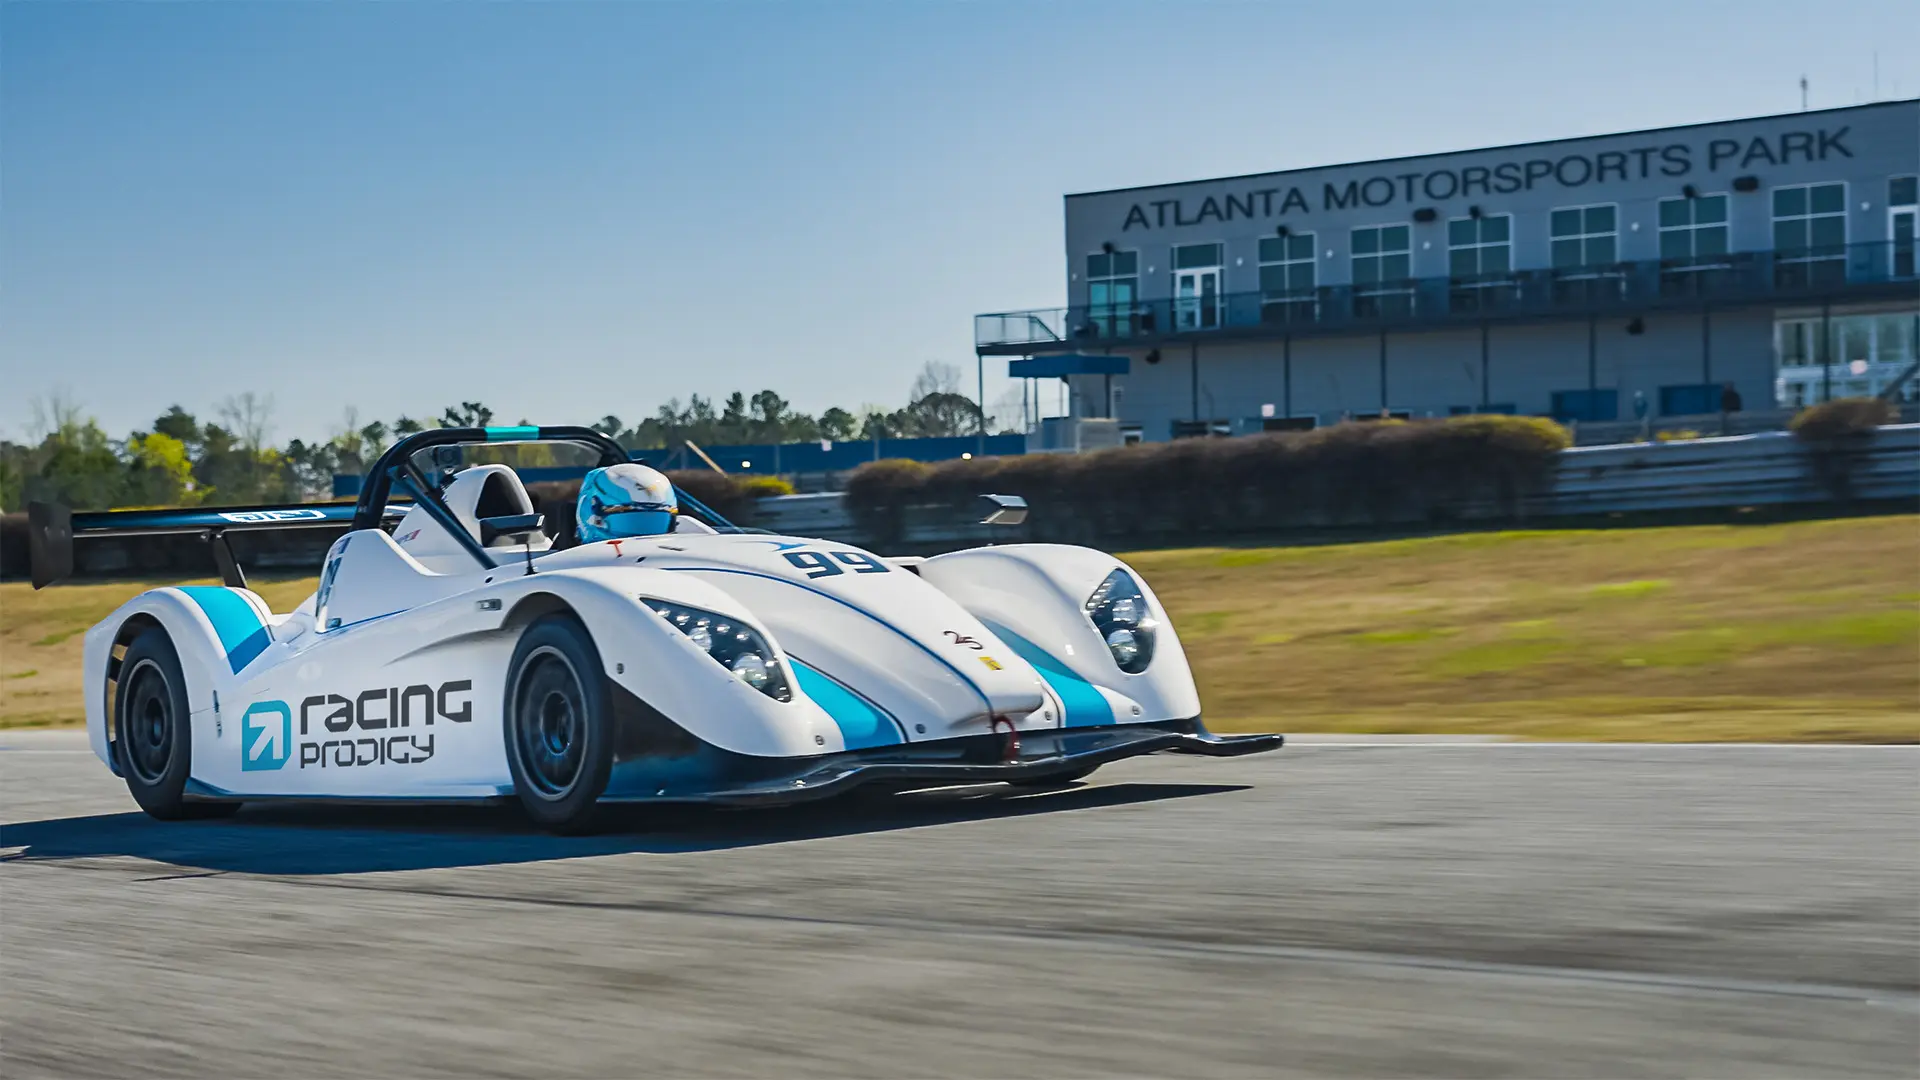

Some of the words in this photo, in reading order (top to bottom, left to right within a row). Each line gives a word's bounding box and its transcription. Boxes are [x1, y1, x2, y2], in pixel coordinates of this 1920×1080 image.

[1122, 186, 1310, 233] ATLANTA
[1323, 143, 1692, 211] MOTORSPORTS
[1708, 126, 1854, 172] PARK
[782, 551, 890, 579] 99
